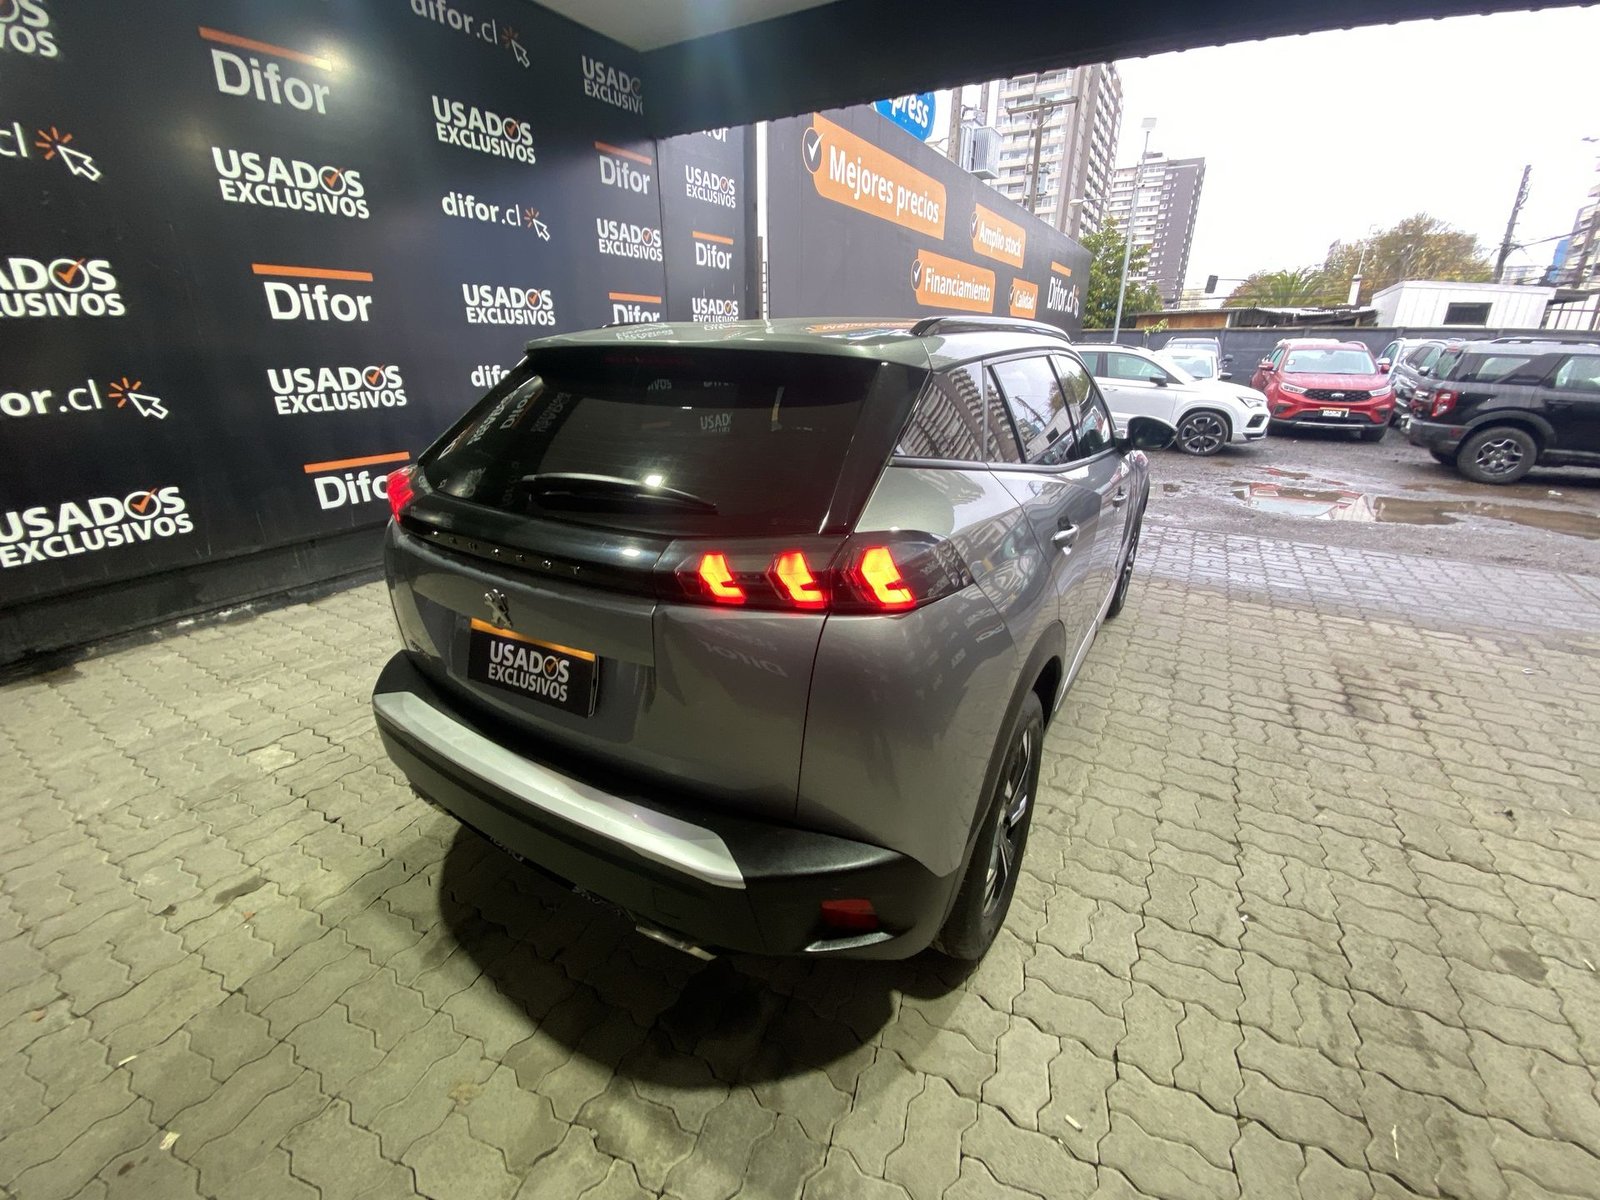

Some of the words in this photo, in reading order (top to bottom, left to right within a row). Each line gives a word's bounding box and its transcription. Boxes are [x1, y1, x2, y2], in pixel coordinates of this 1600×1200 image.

[410, 0, 498, 45] difor.cl
[211, 48, 331, 115] Difor
[431, 95, 533, 146] USADOS
[436, 121, 536, 165] EXCLUSIVOS
[211, 146, 365, 199] USADOS
[599, 155, 651, 195] Difor
[685, 164, 736, 196] USADOS
[828, 145, 894, 205] Mejores
[896, 182, 940, 224] precios
[219, 178, 370, 219] EXCLUSIVOS
[441, 191, 522, 227] difor.cl
[686, 183, 736, 209] EXCLUSIVOS
[596, 217, 662, 247] USADOS
[598, 238, 663, 262] EXCLUSIVOS
[978, 220, 1004, 253] Amplio
[1004, 235, 1022, 256] stock
[695, 242, 732, 270] Difor
[263, 281, 373, 323] Difor
[462, 283, 553, 311] USADOS
[925, 267, 991, 303] Financiamiento
[466, 305, 556, 326] EXCLUSIVOS
[612, 303, 660, 325] Difor
[691, 297, 739, 316] USADOS
[267, 364, 403, 395] USADOS
[274, 388, 408, 415] EXCLUSIVOS
[0, 486, 187, 543] USADOS
[0, 513, 194, 568] EXCLUSIVOS
[489, 640, 570, 684] USADOS
[487, 661, 568, 702] EXCLUSIVOS
